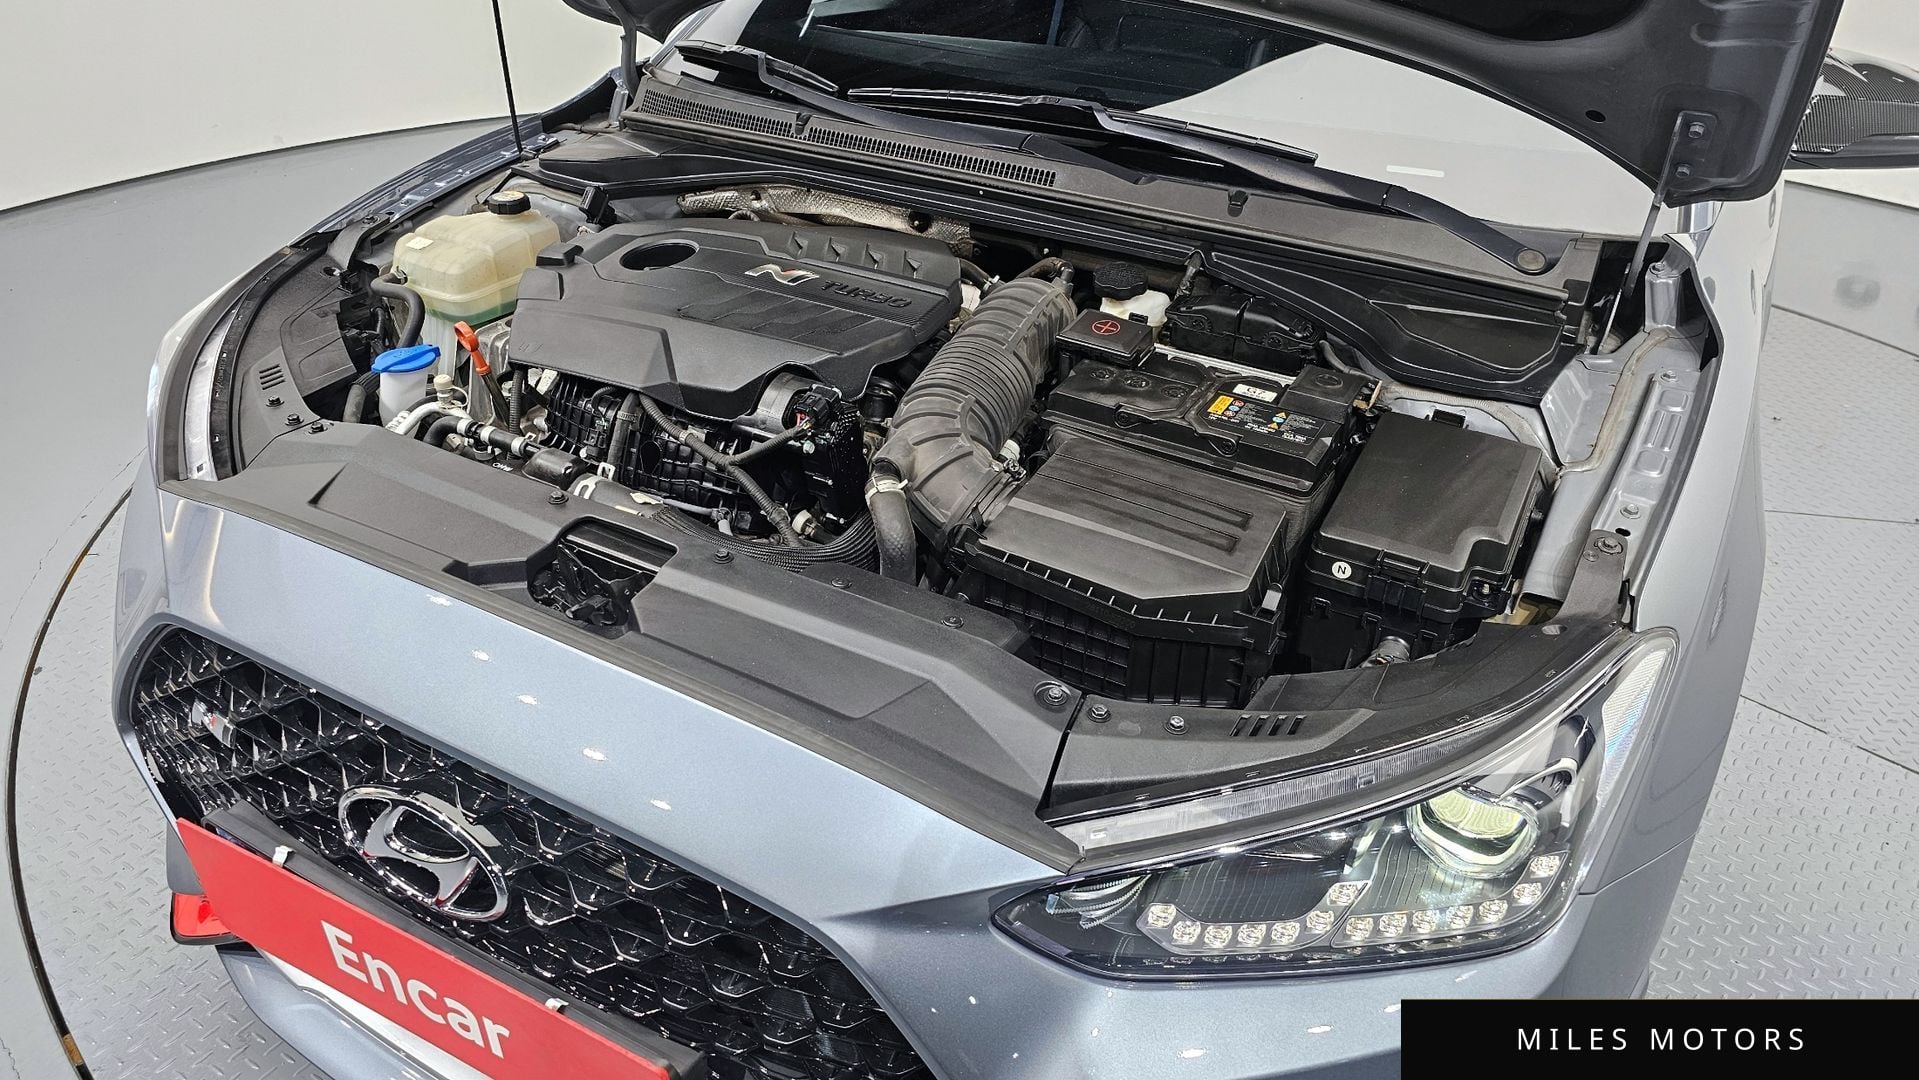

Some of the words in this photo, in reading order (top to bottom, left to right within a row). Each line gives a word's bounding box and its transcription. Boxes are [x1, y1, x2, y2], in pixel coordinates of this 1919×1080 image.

[821, 281, 913, 309] TURBO
[1337, 564, 1347, 575] N
[320, 920, 510, 1059] Encar
